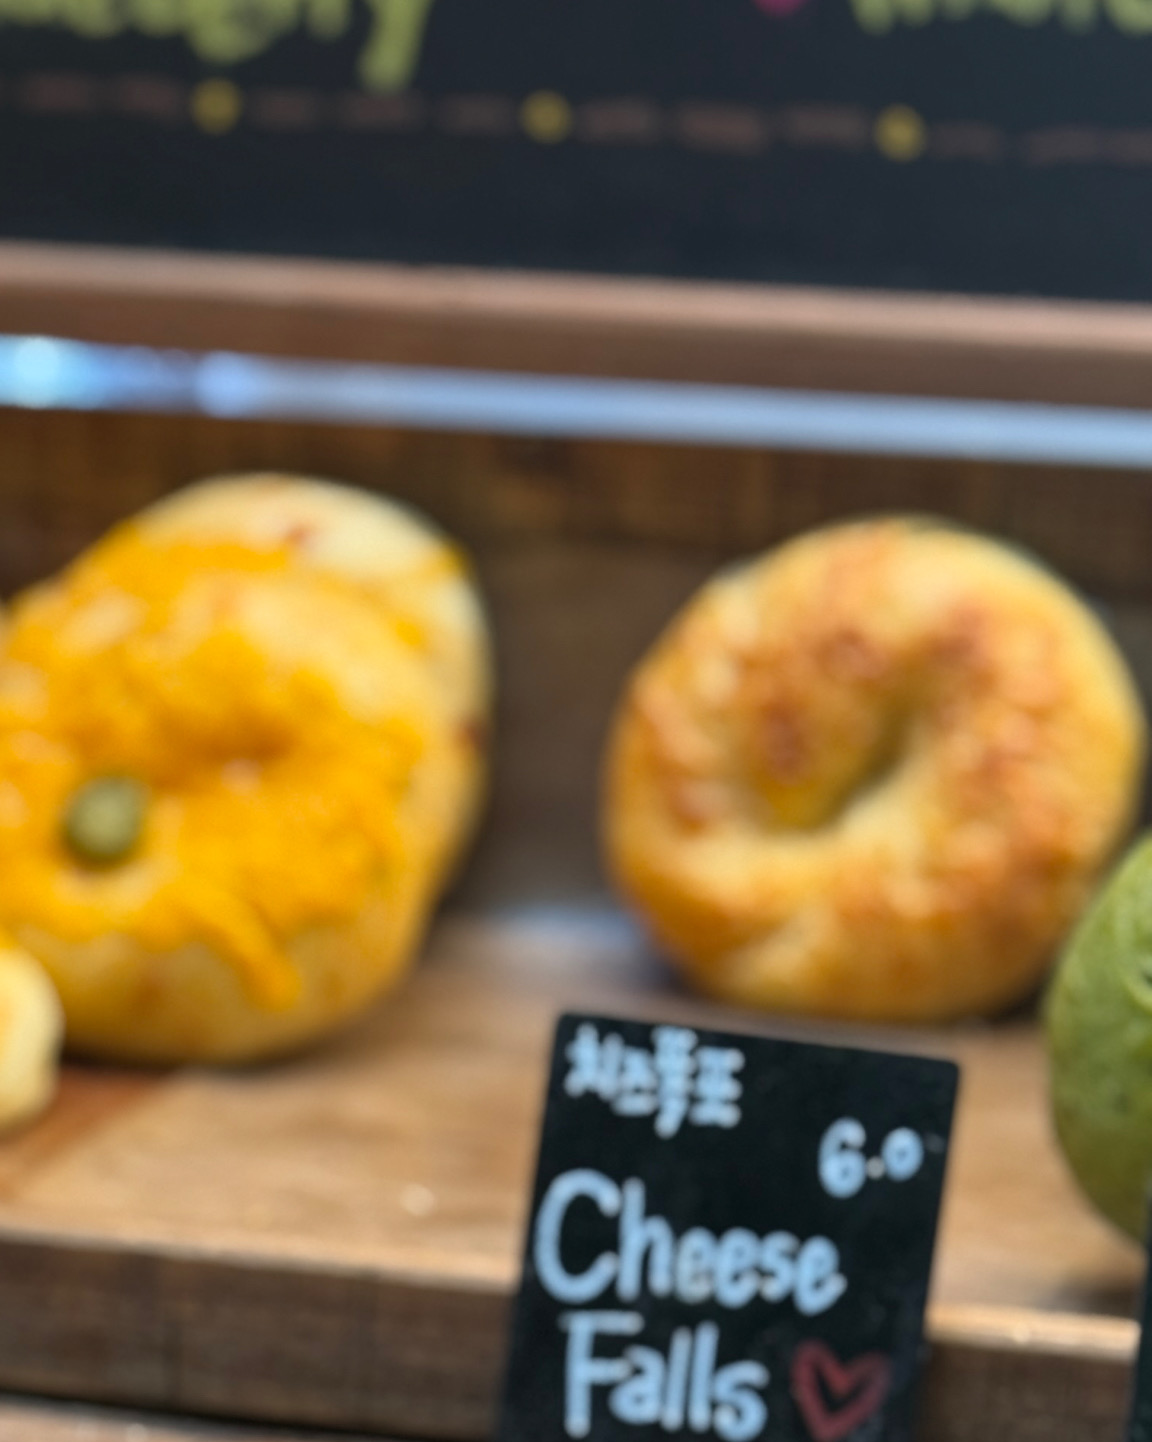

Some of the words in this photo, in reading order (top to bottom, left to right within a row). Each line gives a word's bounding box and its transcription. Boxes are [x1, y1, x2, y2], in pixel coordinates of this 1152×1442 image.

[818, 1117, 924, 1198] 6.0
[534, 1167, 847, 1316] Cheese
[559, 1310, 769, 1442] Falls
